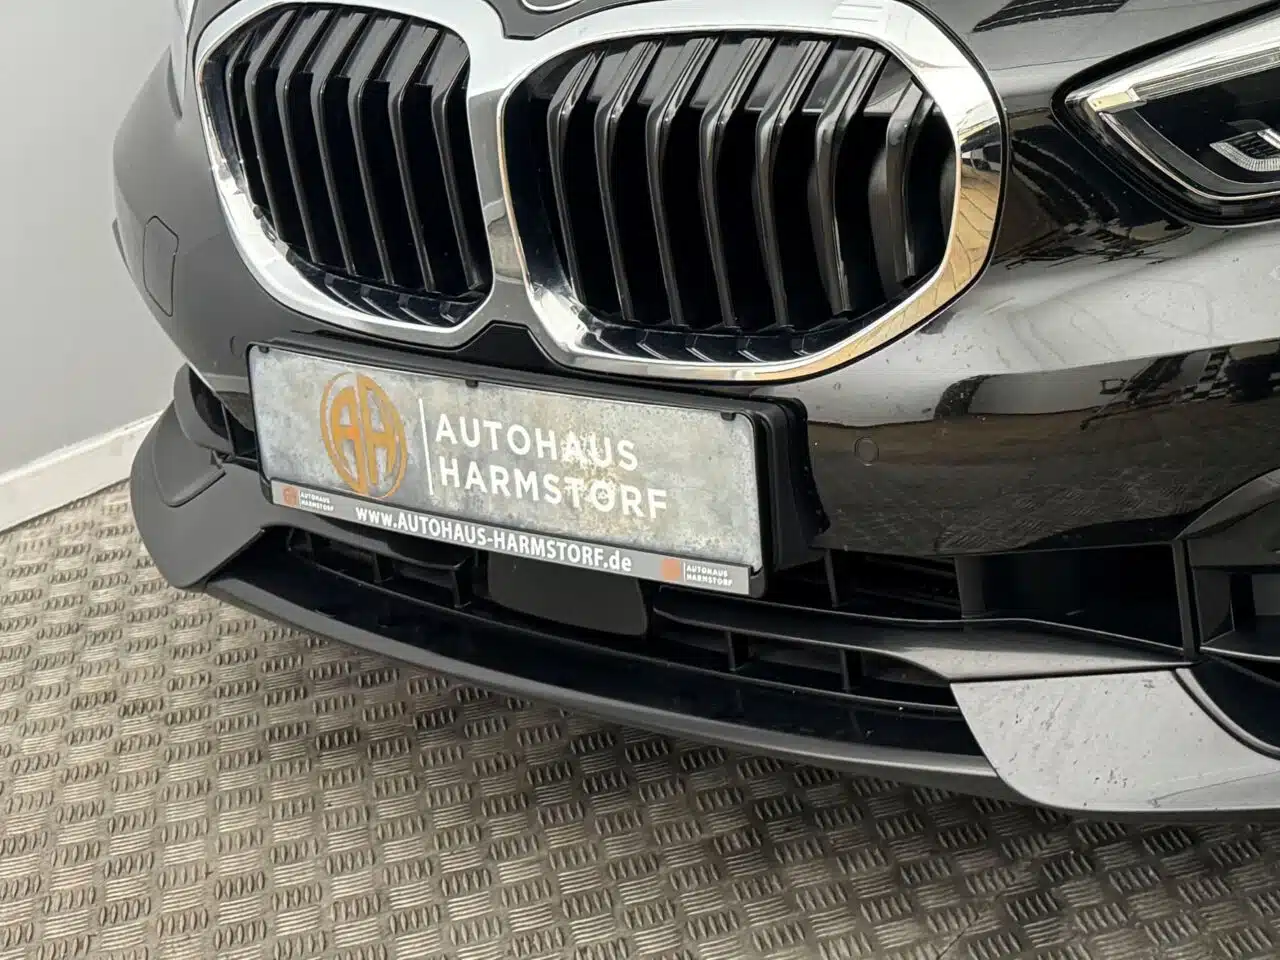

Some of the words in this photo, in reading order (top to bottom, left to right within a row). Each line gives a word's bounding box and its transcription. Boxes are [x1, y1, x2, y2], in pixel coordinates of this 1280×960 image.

[435, 412, 639, 471] AUTOHAUS
[438, 455, 667, 519] HARMSTORF
[355, 506, 632, 572] www.AUTOHAUS-HARMSTORF.de
[686, 565, 728, 577] AUTOHAUS
[686, 574, 732, 586] HARMSTORF
